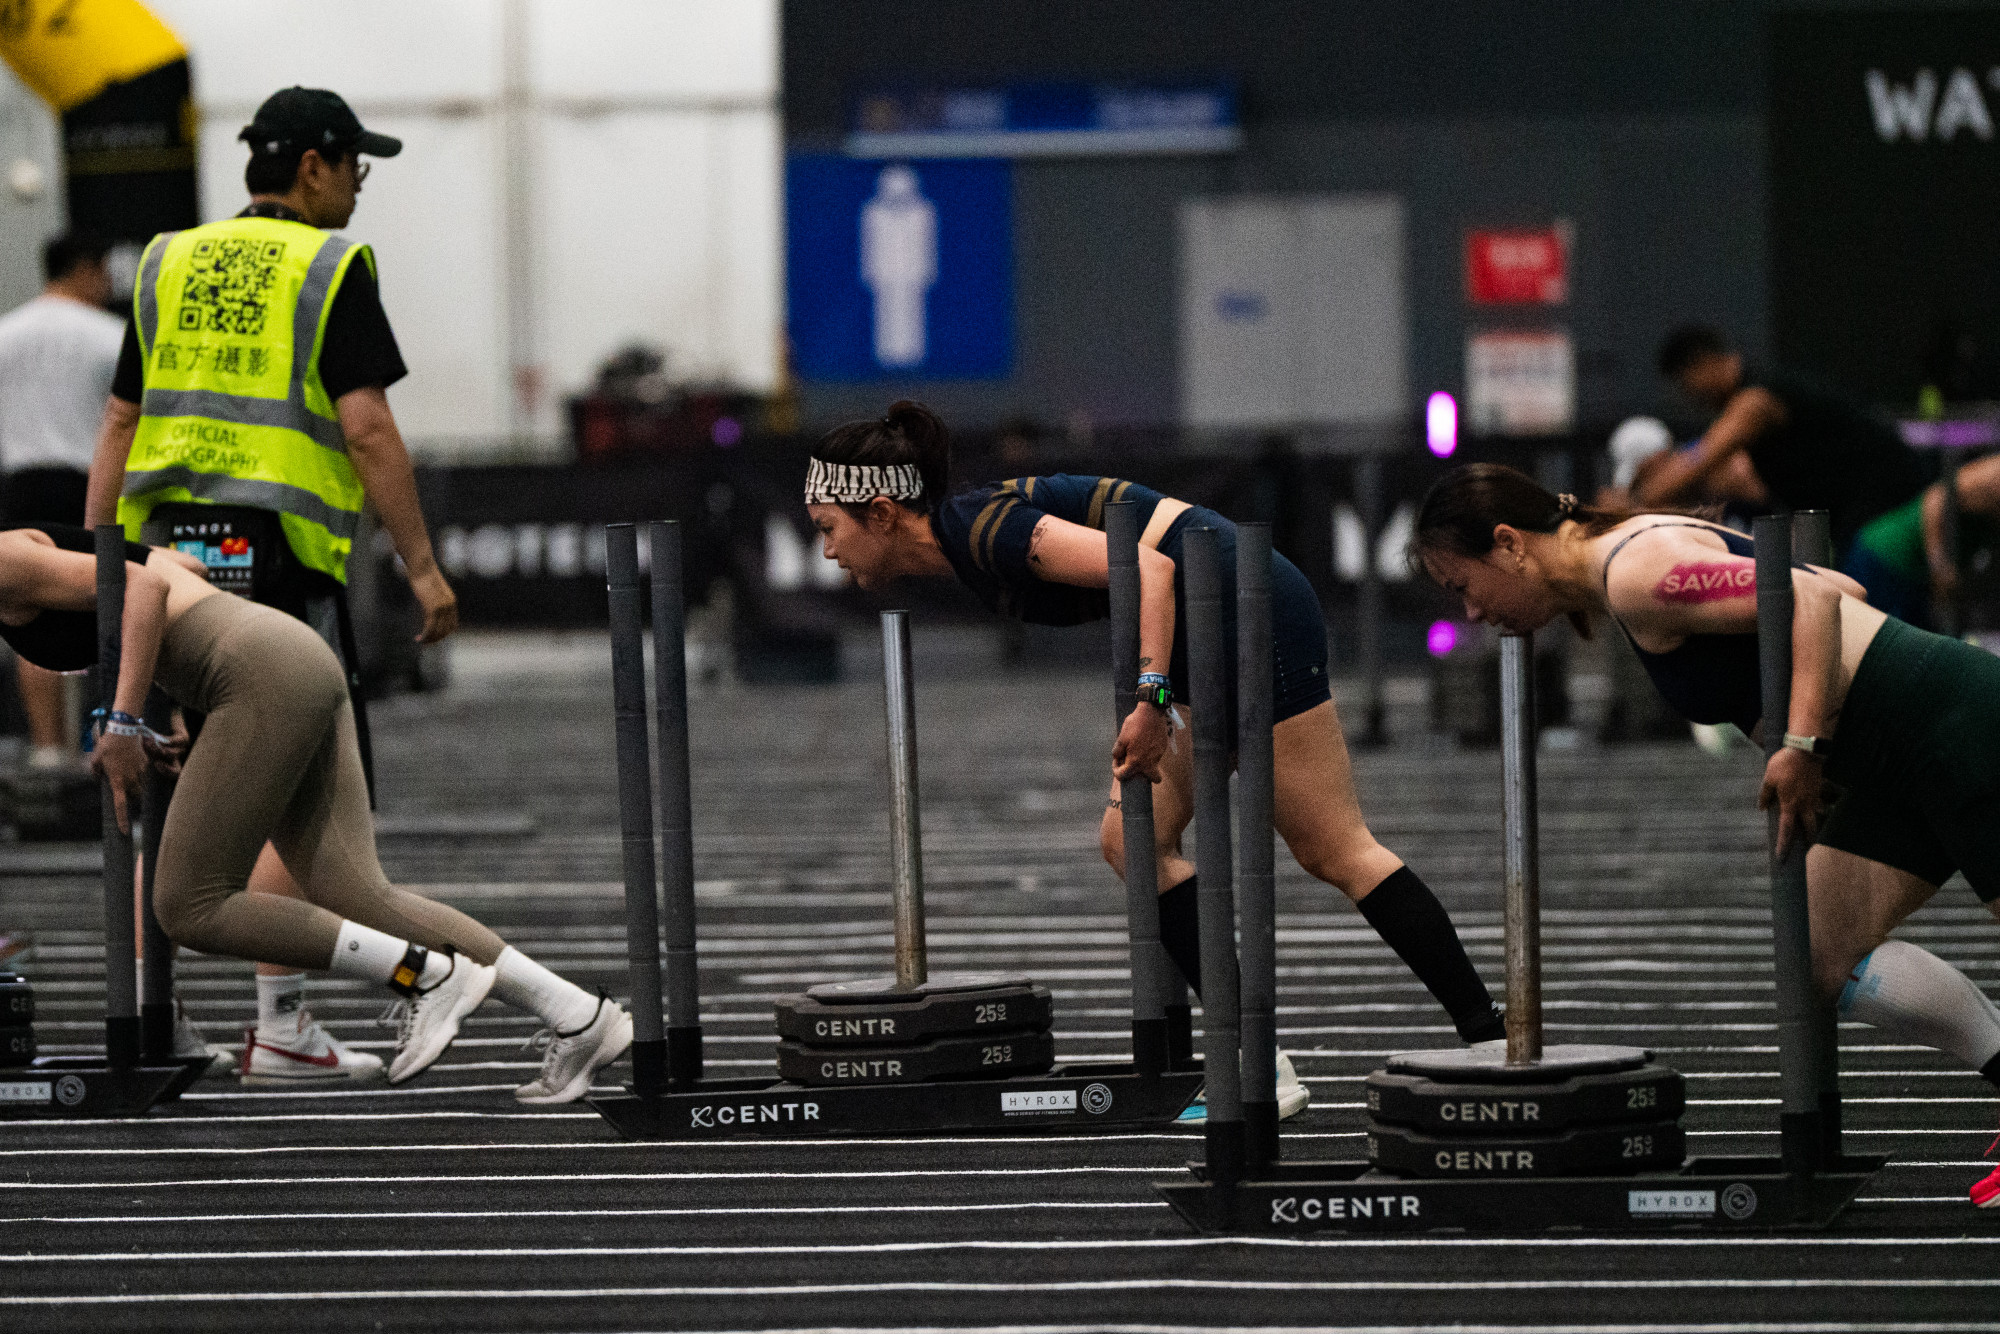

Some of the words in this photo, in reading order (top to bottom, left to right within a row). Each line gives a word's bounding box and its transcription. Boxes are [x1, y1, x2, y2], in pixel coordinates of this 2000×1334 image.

[172, 423, 239, 447] OFFICIAL
[145, 445, 259, 470] PHOTOGRAPHY
[815, 1018, 896, 1037] CENTR
[975, 1004, 996, 1023] 25
[821, 1060, 902, 1078] CENTR
[982, 1046, 1002, 1064] 25
[1009, 1095, 1070, 1106] HYROX
[1440, 1102, 1541, 1122] CENTR
[717, 1102, 820, 1124] CENTR
[1435, 1151, 1534, 1170] CENTR
[1301, 1195, 1420, 1220] CENTR
[1637, 1196, 1708, 1207] HYROX
